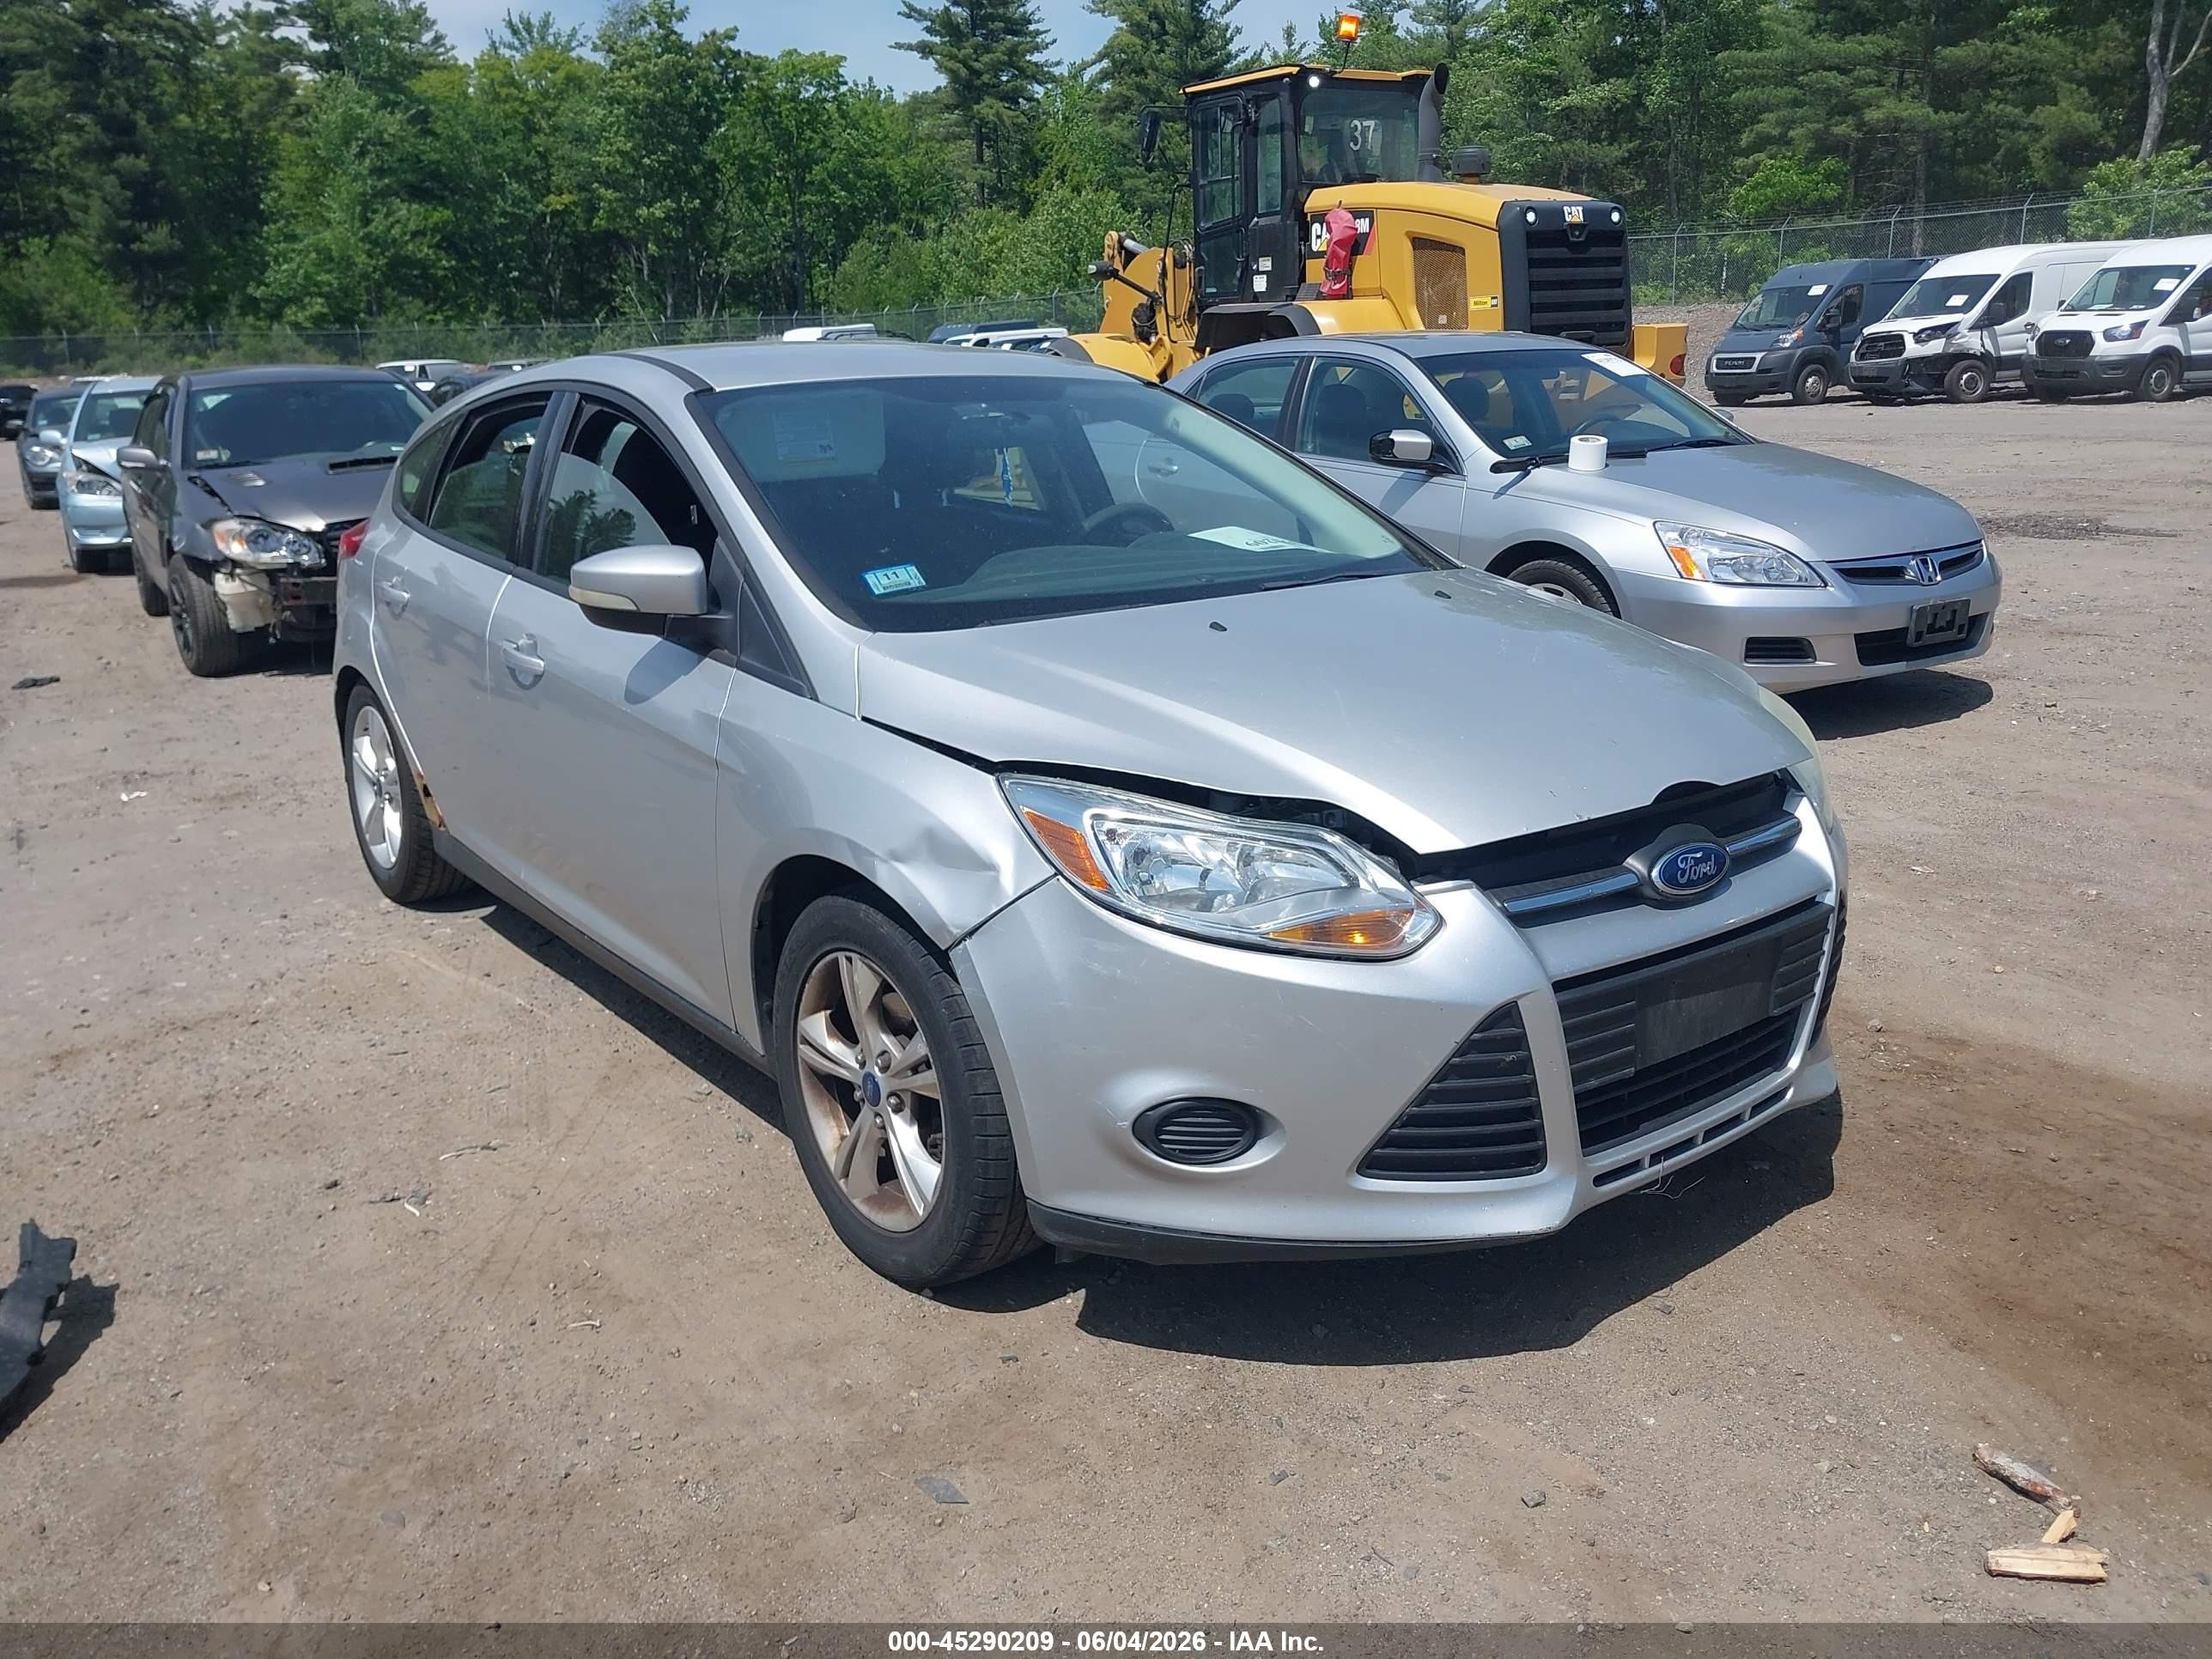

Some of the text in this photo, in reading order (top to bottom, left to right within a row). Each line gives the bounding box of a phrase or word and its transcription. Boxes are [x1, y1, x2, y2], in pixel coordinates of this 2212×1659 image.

[1349, 119, 1375, 151] 37
[1563, 205, 1583, 222] CAT
[1311, 217, 1370, 252] CA 8M
[883, 571, 900, 580] 11
[1677, 851, 1717, 884] Ford
